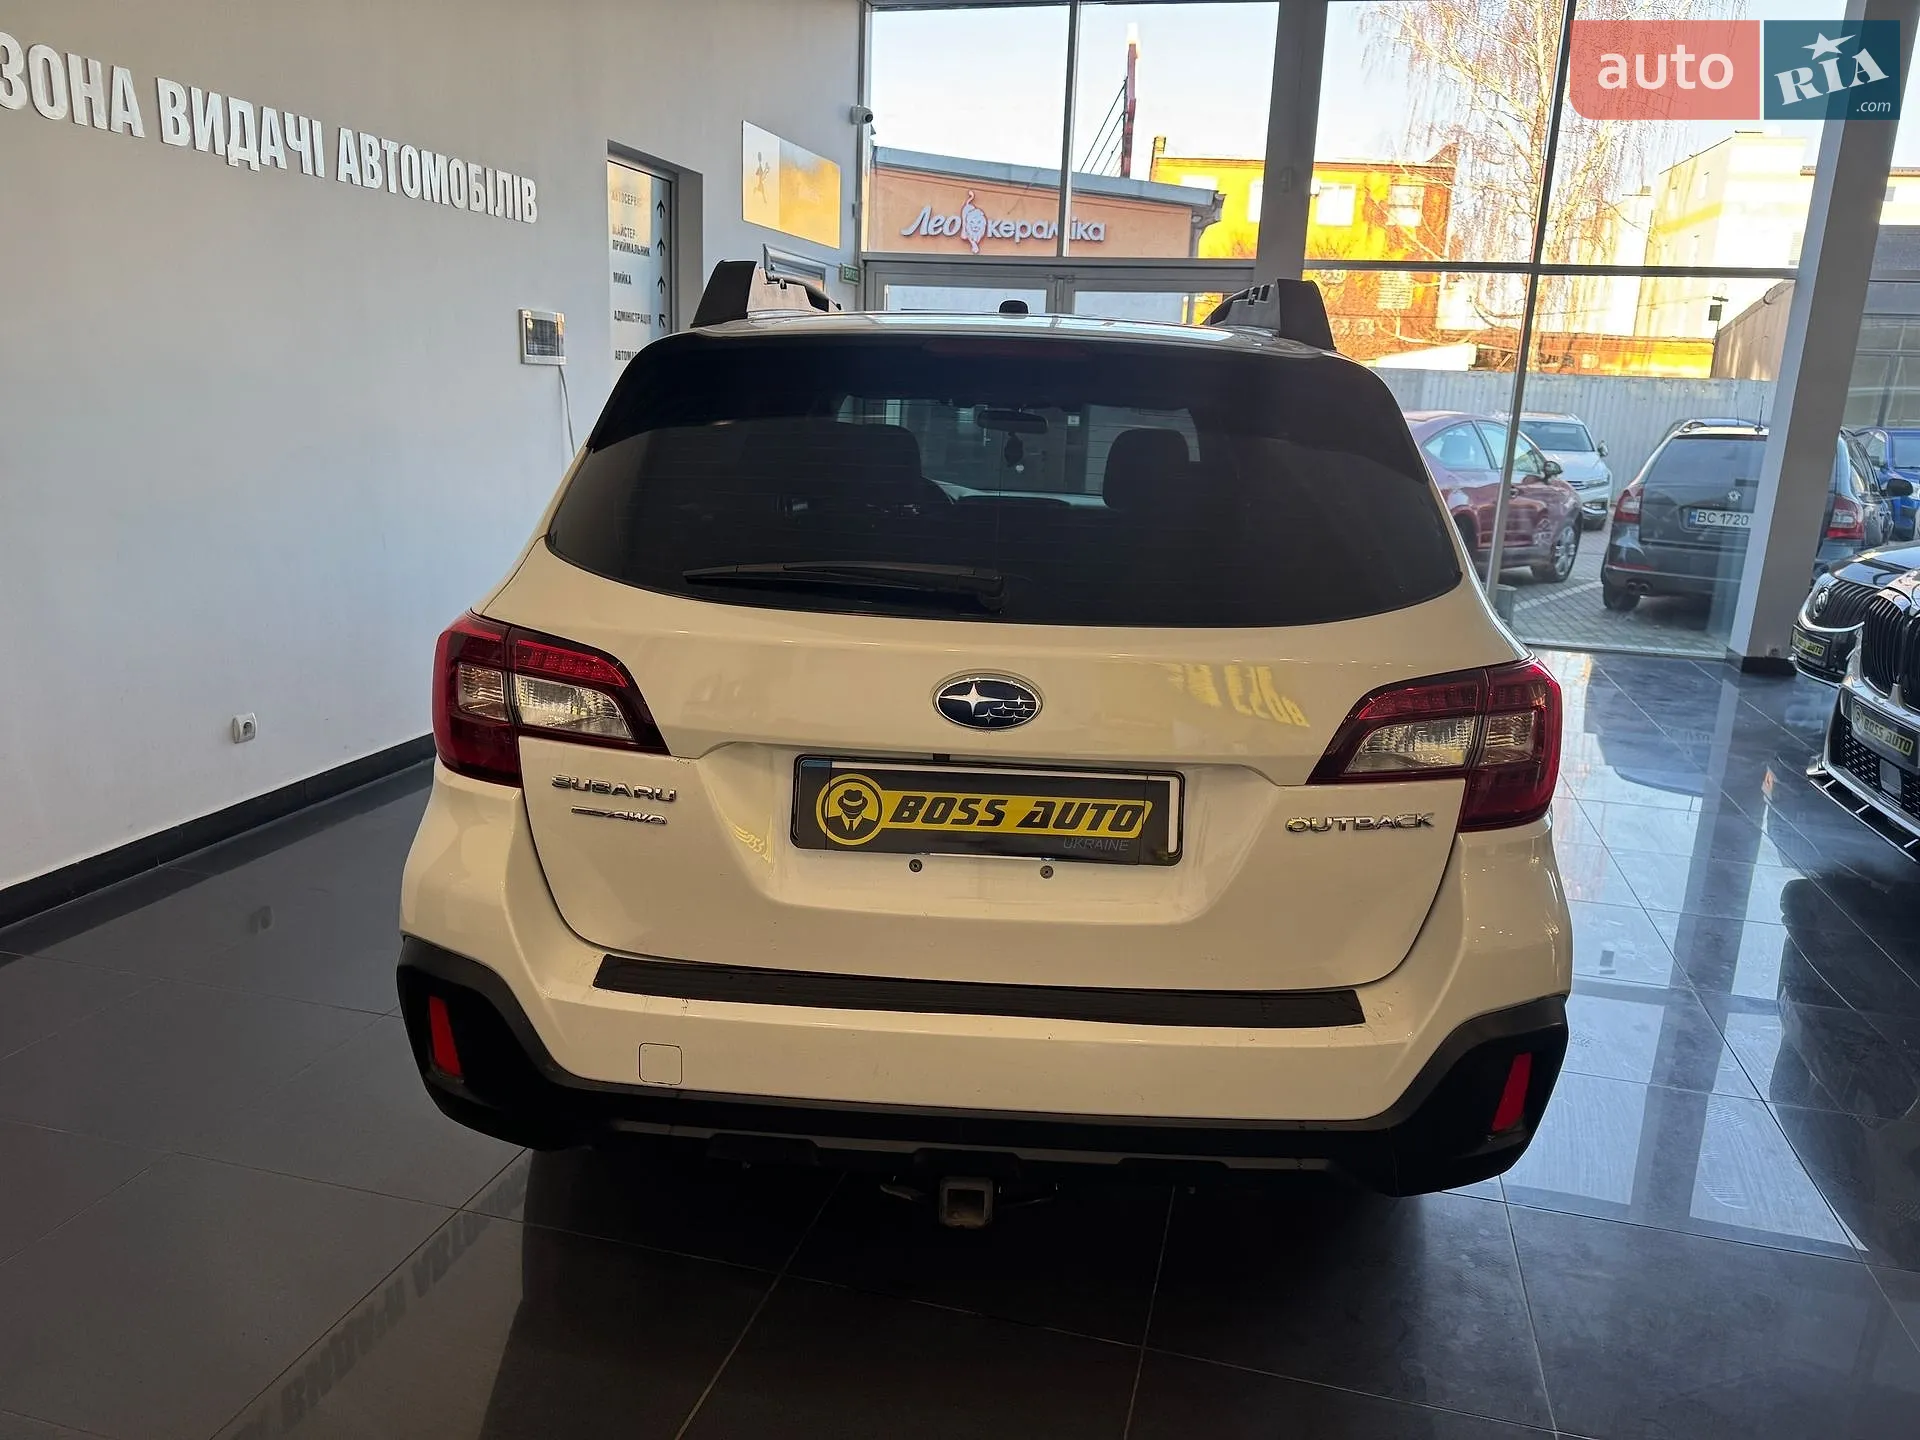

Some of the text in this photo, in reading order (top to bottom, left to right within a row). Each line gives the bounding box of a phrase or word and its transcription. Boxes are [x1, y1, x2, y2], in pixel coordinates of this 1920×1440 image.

[0, 32, 538, 224] ЗОНА ВИДАЧІ АВТОМОБІЛІВ
[901, 204, 962, 237] Лео
[1697, 511, 1749, 526] BC 1720
[551, 774, 677, 802] SUBARU
[606, 811, 668, 825] AWD
[888, 795, 1147, 832] BOSS AUTO
[1286, 813, 1435, 833] OUTBACK
[1063, 837, 1129, 852] UKRAINE
